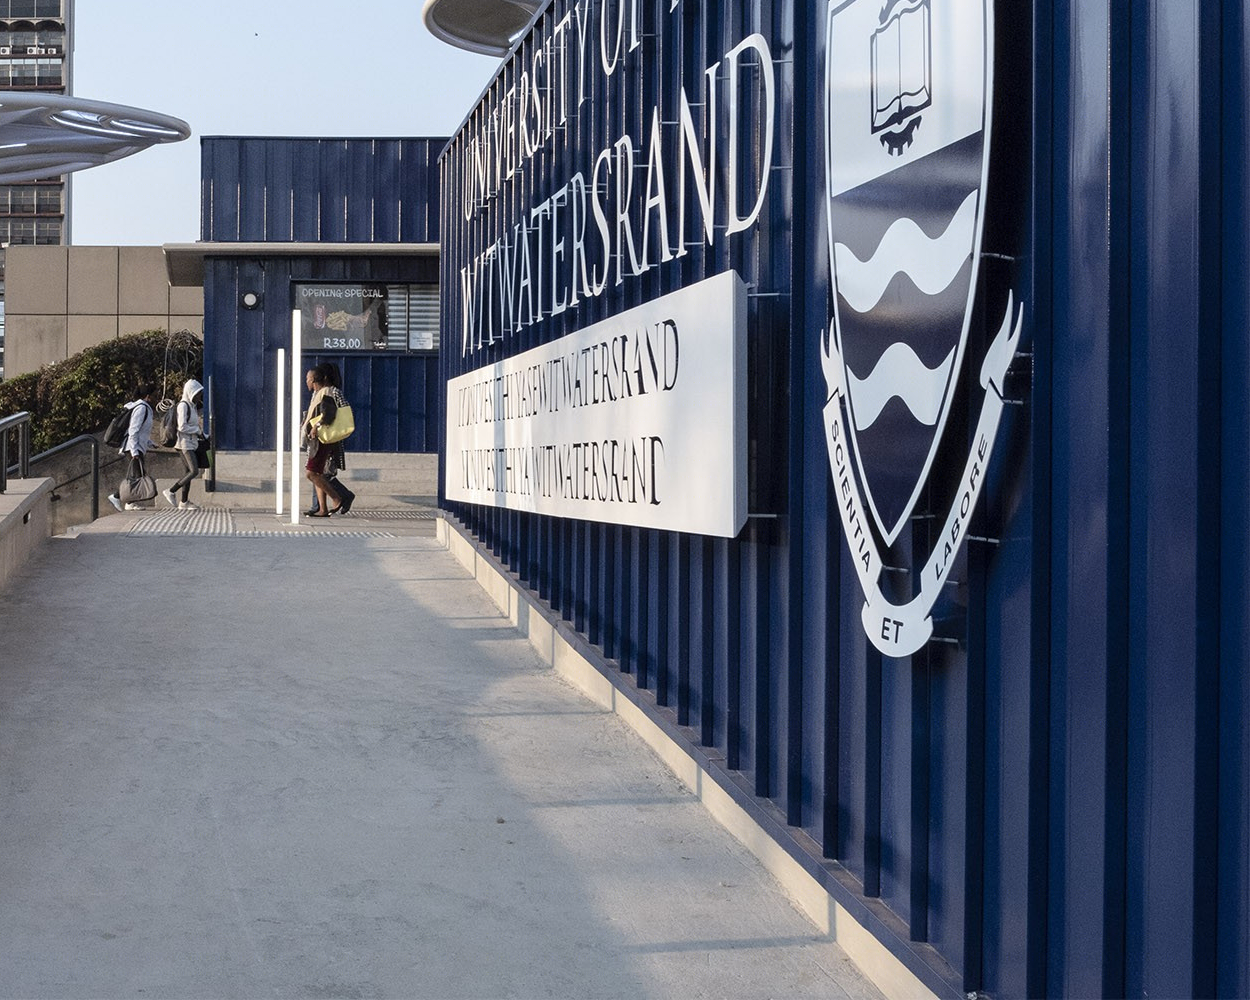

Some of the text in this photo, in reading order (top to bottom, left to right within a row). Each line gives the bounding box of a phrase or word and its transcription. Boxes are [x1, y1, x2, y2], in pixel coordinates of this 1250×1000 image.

[460, 32, 775, 358] WITWATERSRAND
[302, 288, 384, 298] OPENING SPECIAL
[323, 337, 361, 349] R38,00
[831, 418, 871, 573] SCIENTIA
[934, 433, 988, 580] LABORE
[880, 616, 904, 644] ET
